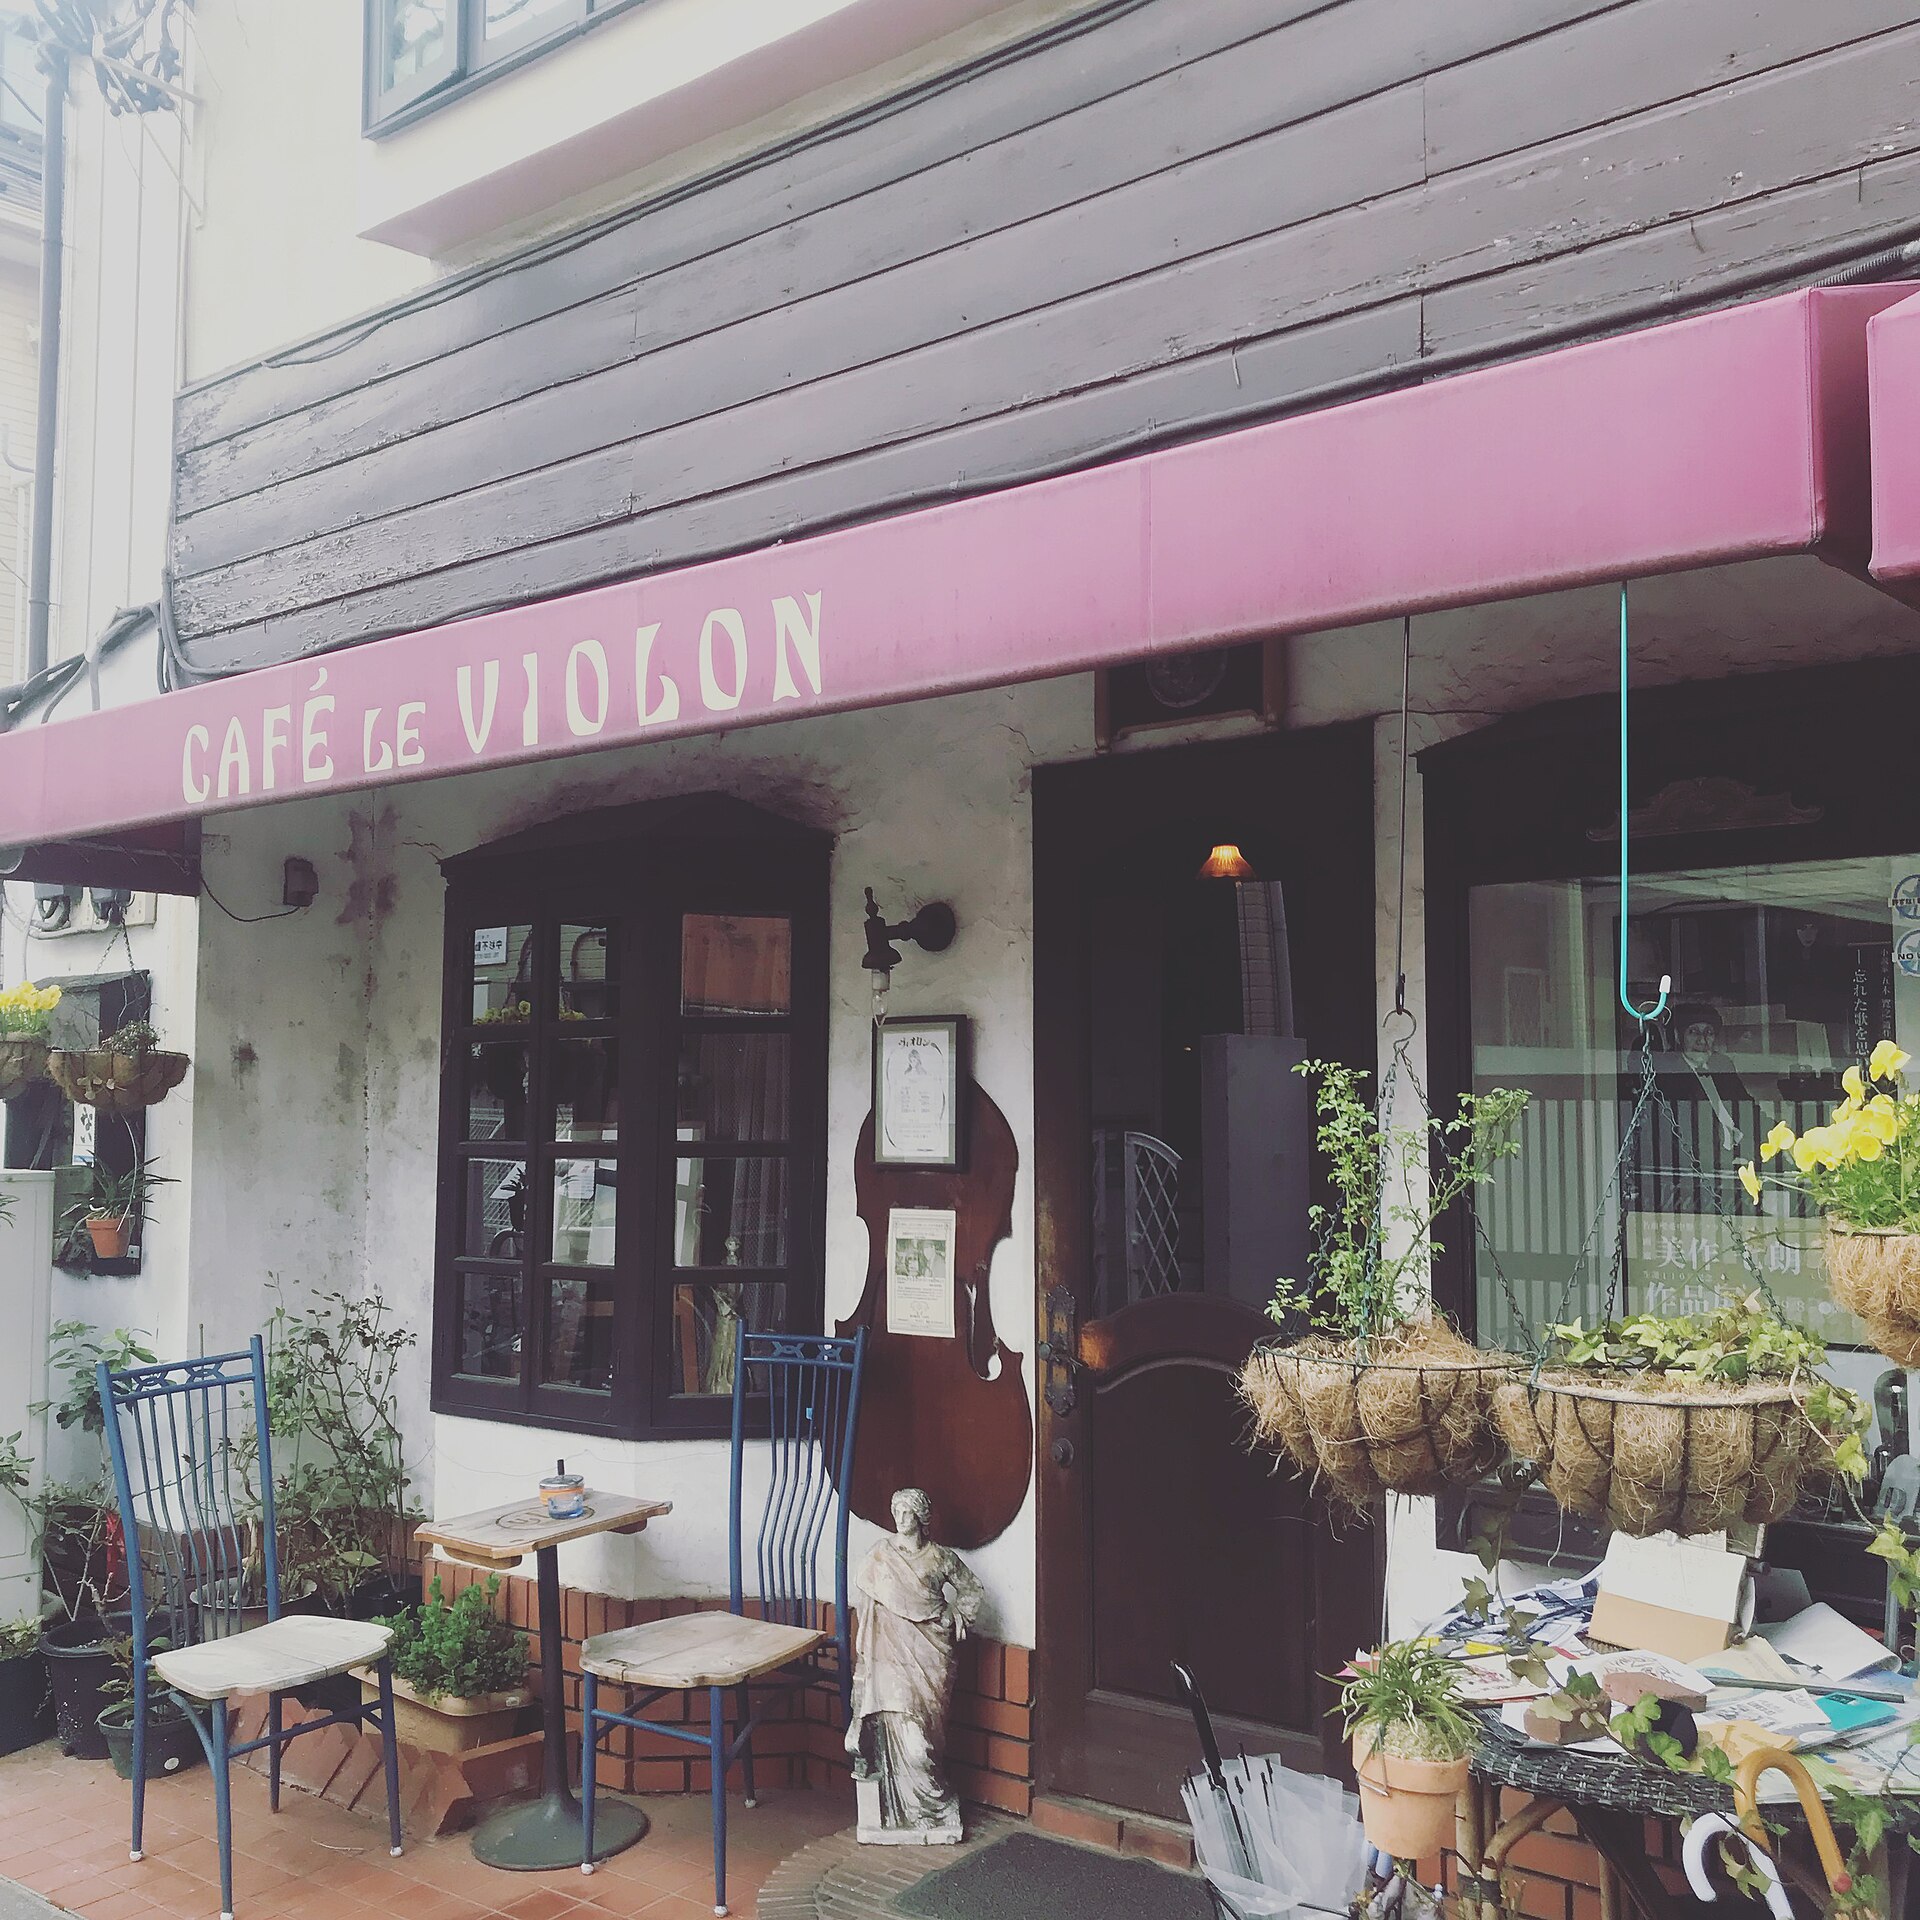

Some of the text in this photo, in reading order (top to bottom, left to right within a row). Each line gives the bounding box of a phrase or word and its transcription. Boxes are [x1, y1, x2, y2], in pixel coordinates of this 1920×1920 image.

[182, 589, 823, 805] CAFÉ LE VIOLON
